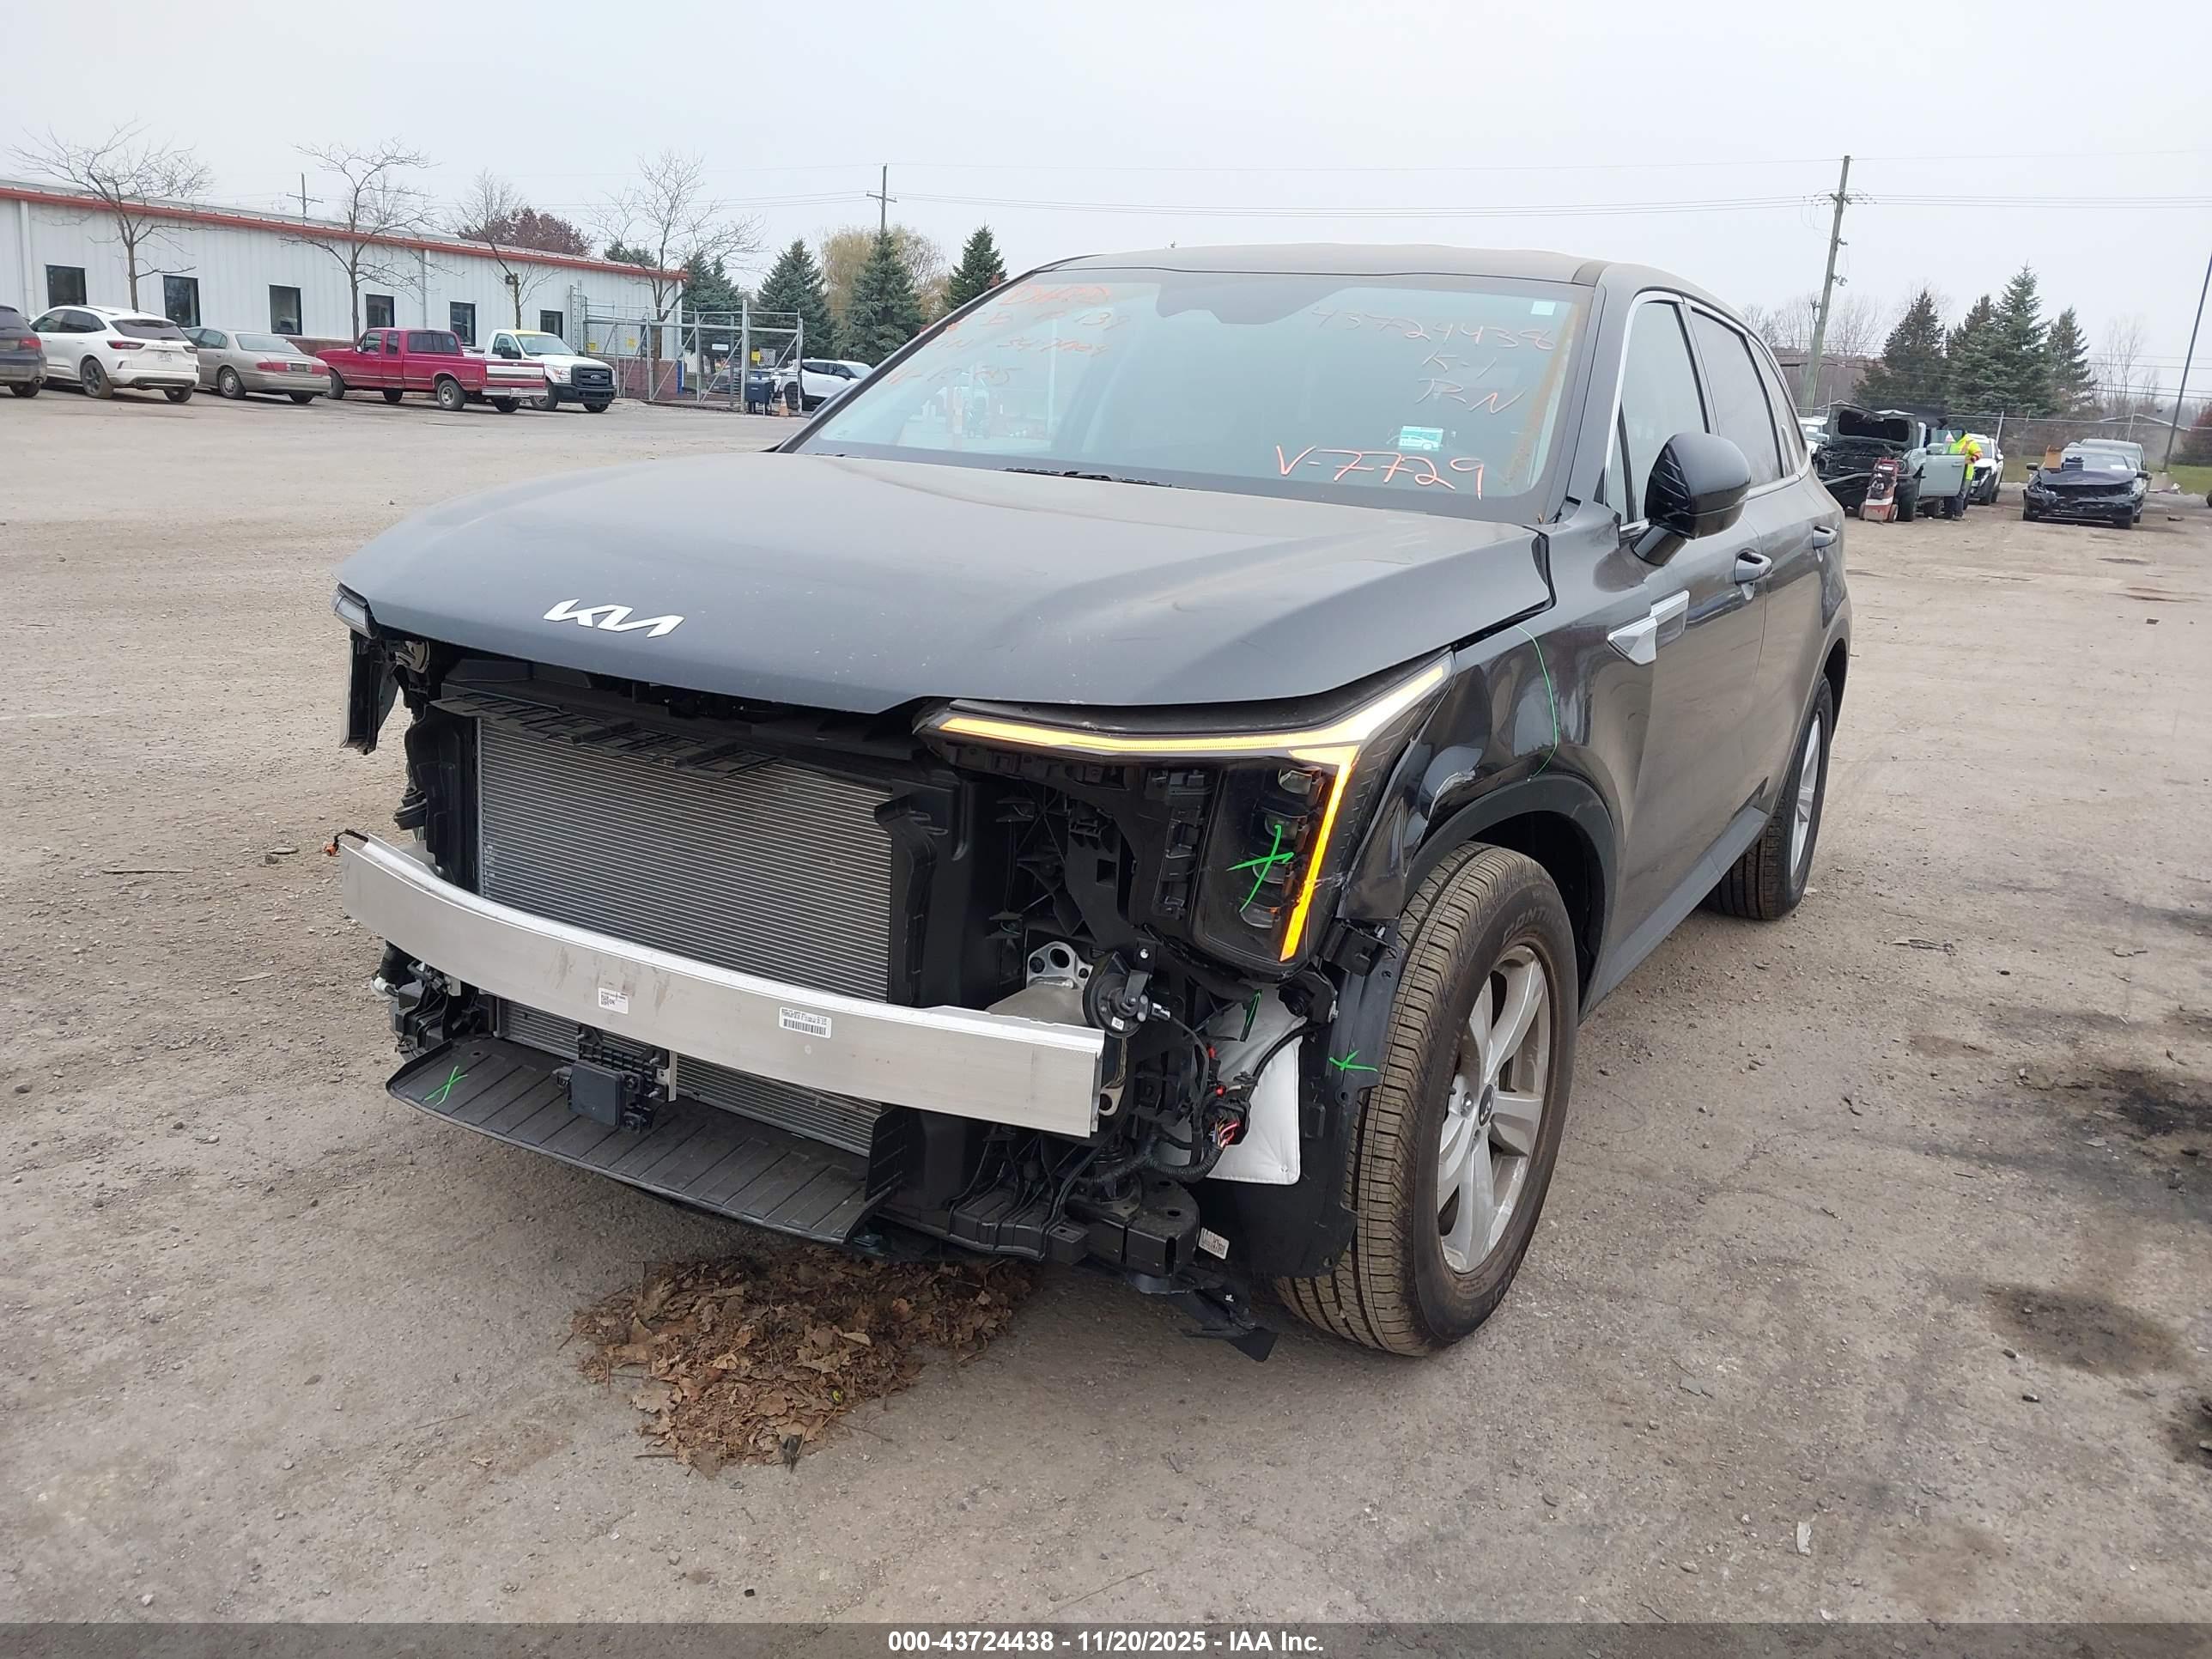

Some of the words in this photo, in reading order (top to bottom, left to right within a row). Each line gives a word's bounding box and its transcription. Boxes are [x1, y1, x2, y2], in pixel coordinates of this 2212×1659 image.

[1311, 306, 1556, 351] 43724438
[1275, 445, 1485, 501] V-7729
[543, 599, 685, 638] KIA
